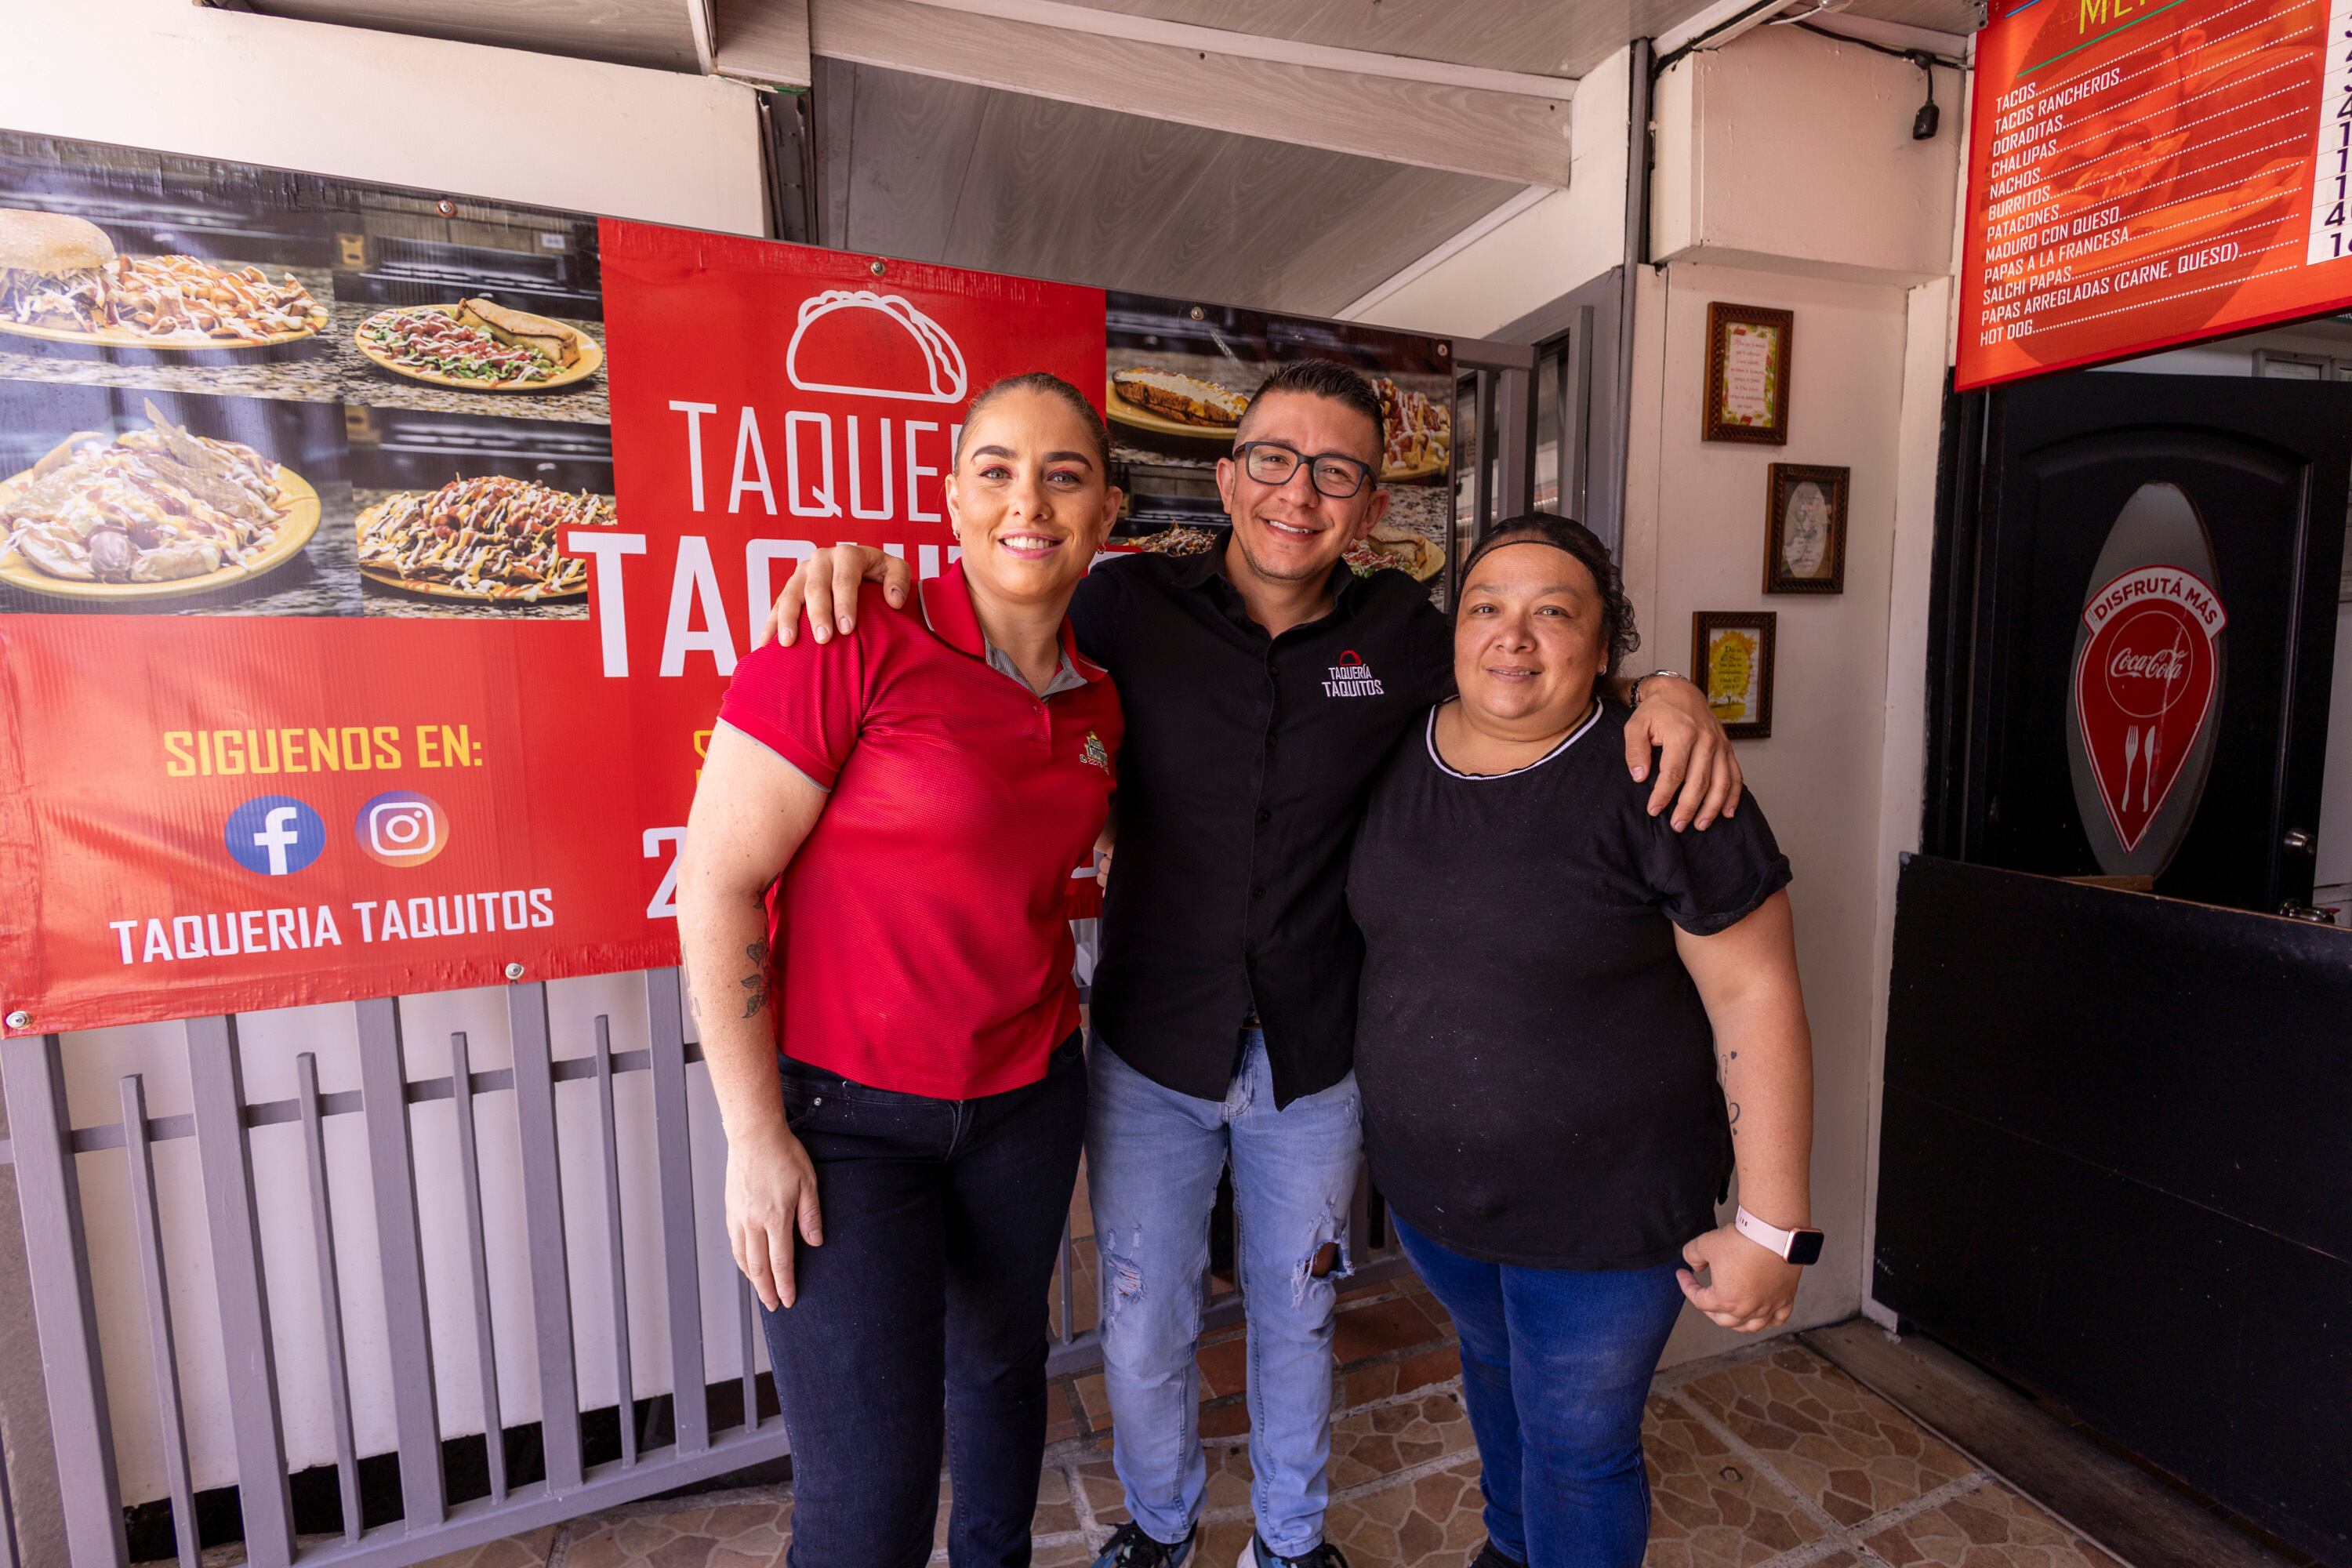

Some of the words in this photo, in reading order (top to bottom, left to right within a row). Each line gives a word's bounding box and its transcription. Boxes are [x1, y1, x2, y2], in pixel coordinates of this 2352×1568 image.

[1994, 104, 2034, 135] TACOS
[2038, 67, 2120, 117] RANCHEROS
[1996, 82, 2036, 114] TACOS
[1992, 114, 2063, 158] DORADITAS
[1991, 139, 2057, 179] CHALUPAS
[1988, 185, 2050, 221] BURRITOS
[1990, 167, 2040, 200] NACHOS
[1987, 204, 2060, 242] PATACONES
[2325, 201, 2352, 226] 4
[1985, 233, 2037, 263] MADURO
[2042, 223, 2069, 245] CON
[2073, 206, 2120, 236] QUESO
[1984, 259, 2024, 284] PAPAS
[2027, 256, 2035, 271] A
[2039, 249, 2054, 268] LA
[2059, 226, 2129, 263] FRANCESA
[1981, 302, 2020, 326] PAPAS
[2024, 277, 2110, 315] ARREGLADAS
[2114, 260, 2172, 292] (CARNE,
[2178, 242, 2238, 274] QUESO)
[1983, 279, 2026, 306] SALCHI
[2029, 265, 2072, 292] PAPAS
[1980, 326, 2005, 347] HOT
[2007, 319, 2034, 339] DOG
[2094, 577, 2183, 622] DISFRUTÁ
[2184, 587, 2217, 625] MÁS
[2111, 648, 2189, 679] Coca-Cola
[1321, 679, 1385, 697] TAQUITOS
[163, 726, 403, 776] SIGUENOS
[416, 724, 484, 768] EN:
[110, 904, 342, 965] TAQUERIA
[351, 887, 555, 941] TAQUITOS
